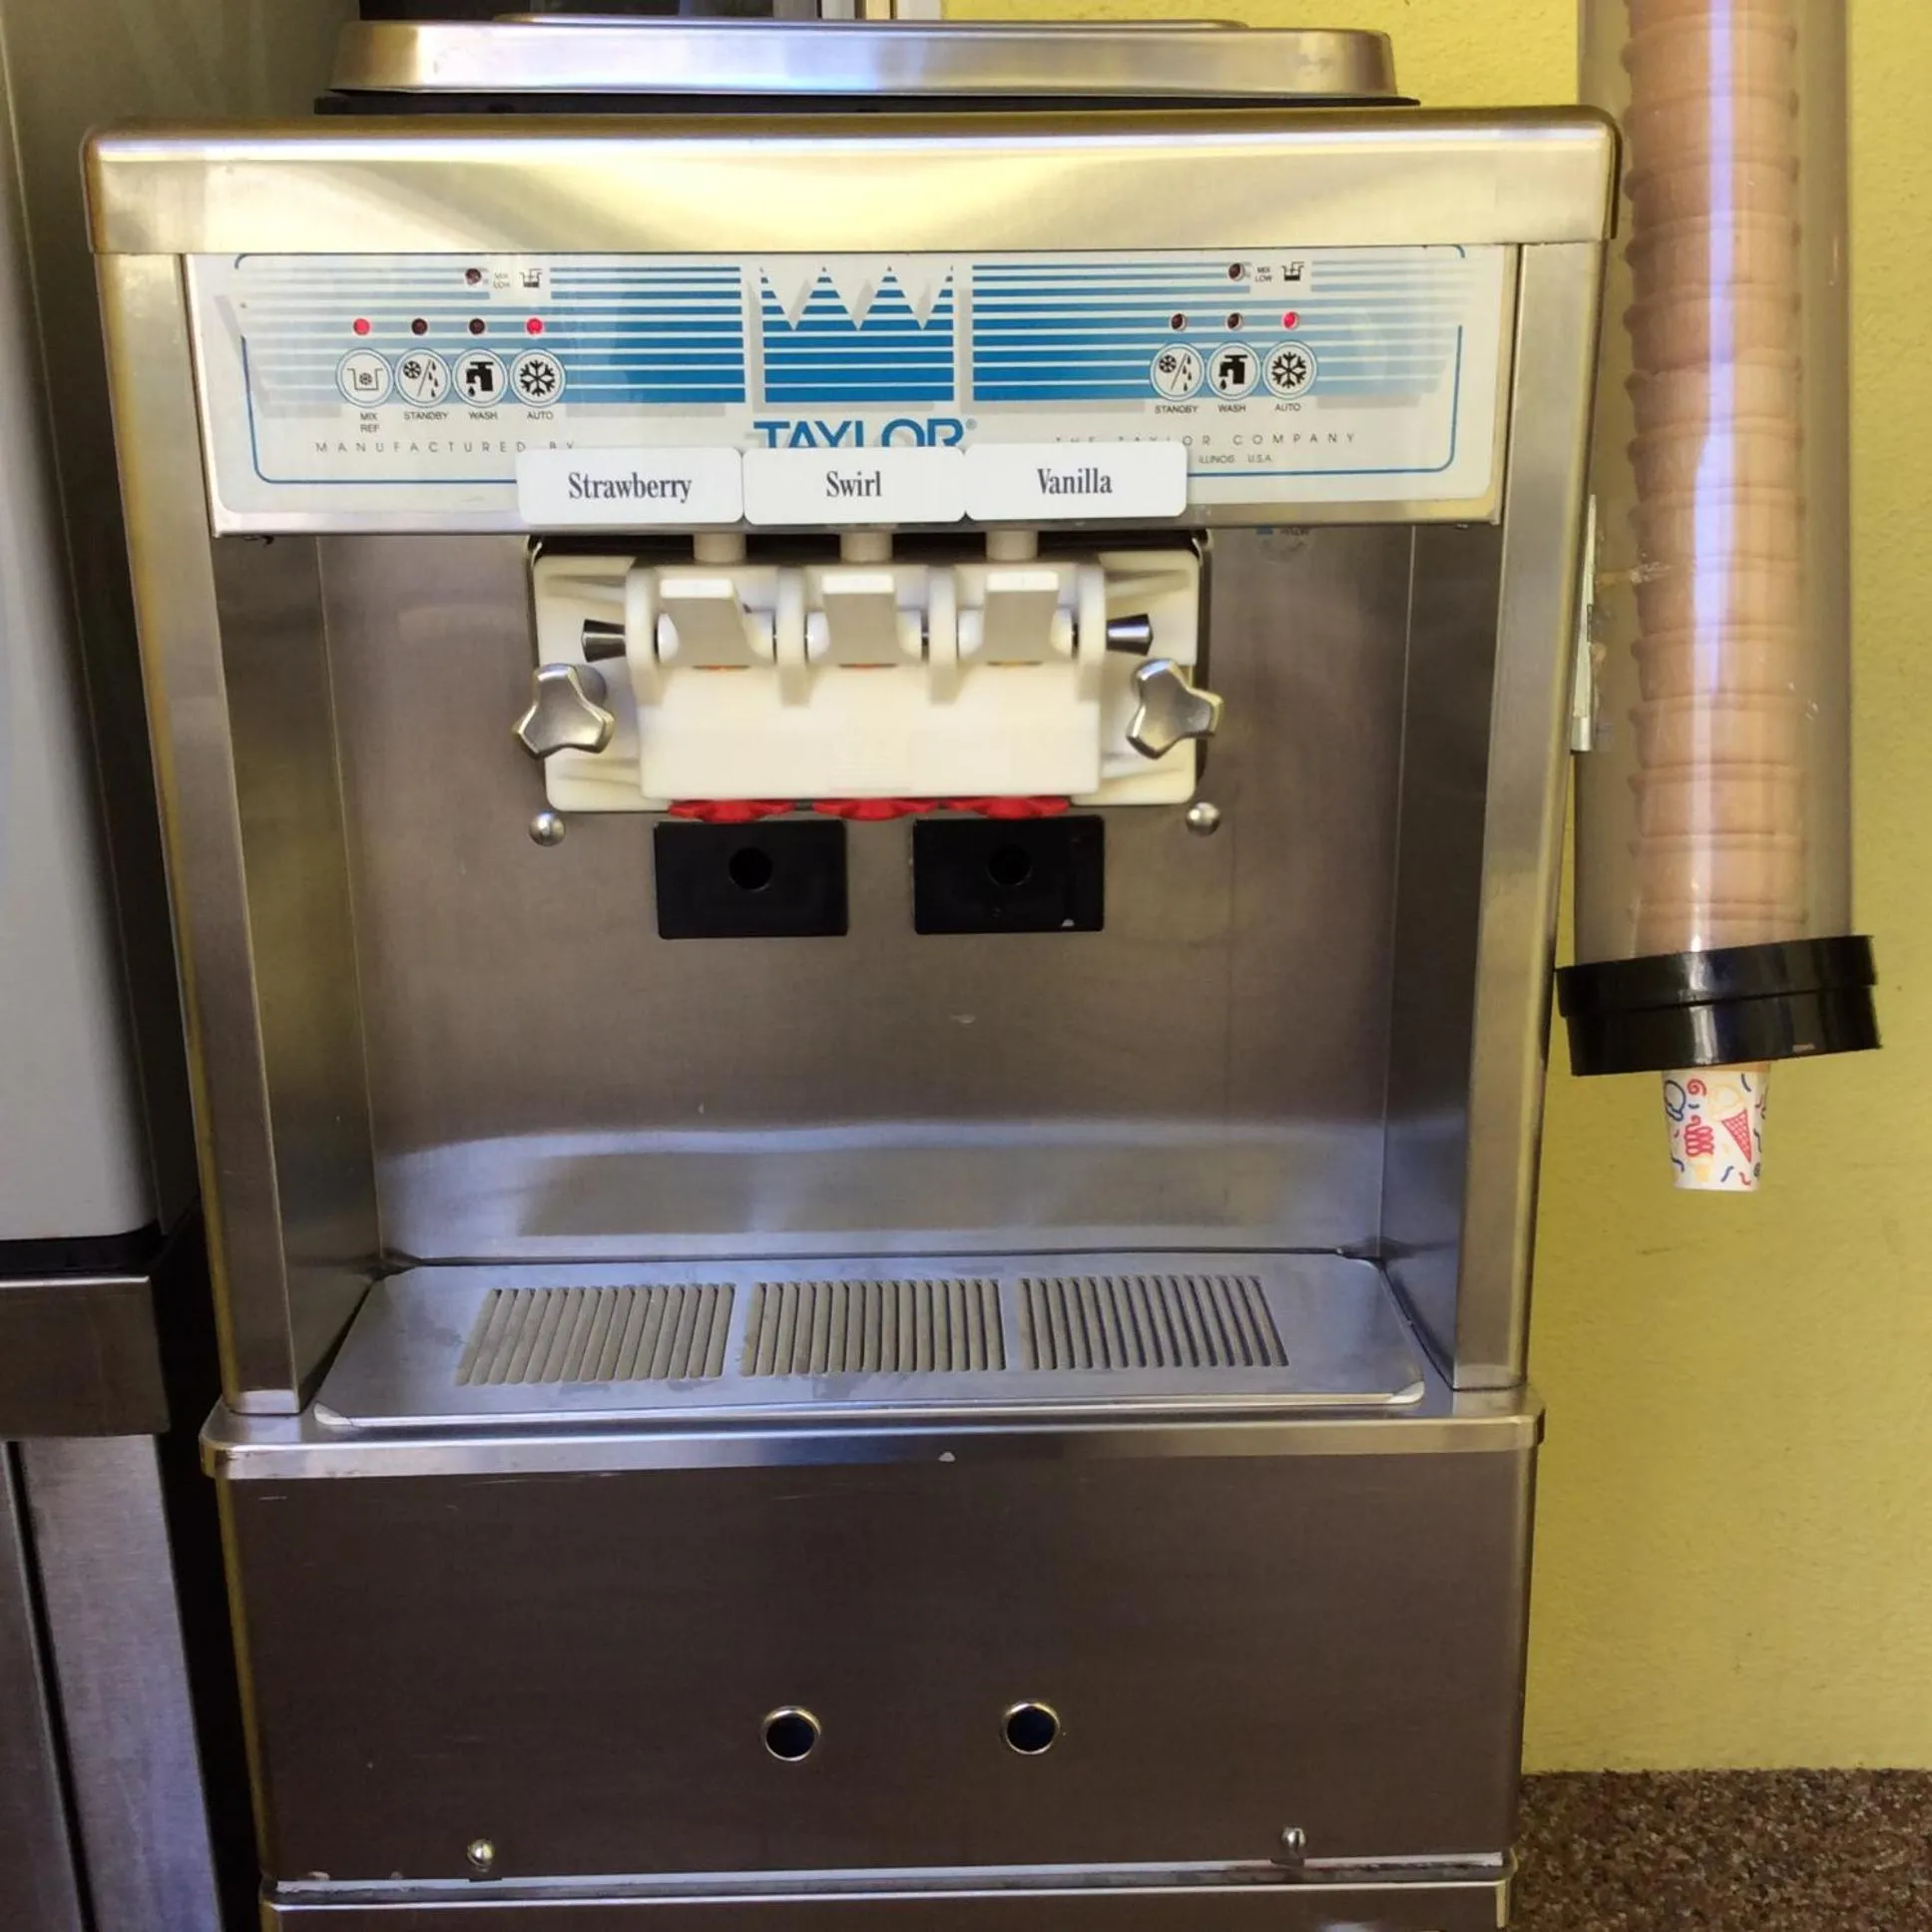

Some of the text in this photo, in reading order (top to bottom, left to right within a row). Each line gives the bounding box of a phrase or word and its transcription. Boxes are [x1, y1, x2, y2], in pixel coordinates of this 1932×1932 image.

[1154, 403, 1199, 414] STANDBY
[1217, 403, 1246, 413] WASH
[1273, 402, 1301, 412] AUTO
[359, 411, 377, 422] MIX
[403, 411, 449, 421] STANDBY
[467, 411, 498, 421] WASH
[526, 411, 554, 421] AUTO
[359, 423, 380, 433] REF
[1232, 432, 1355, 446] COMPANY
[315, 441, 527, 453] MANUFACTURED
[825, 470, 882, 498] Swirl
[1036, 467, 1114, 496] Vanilla
[567, 471, 693, 504] Strawberry
